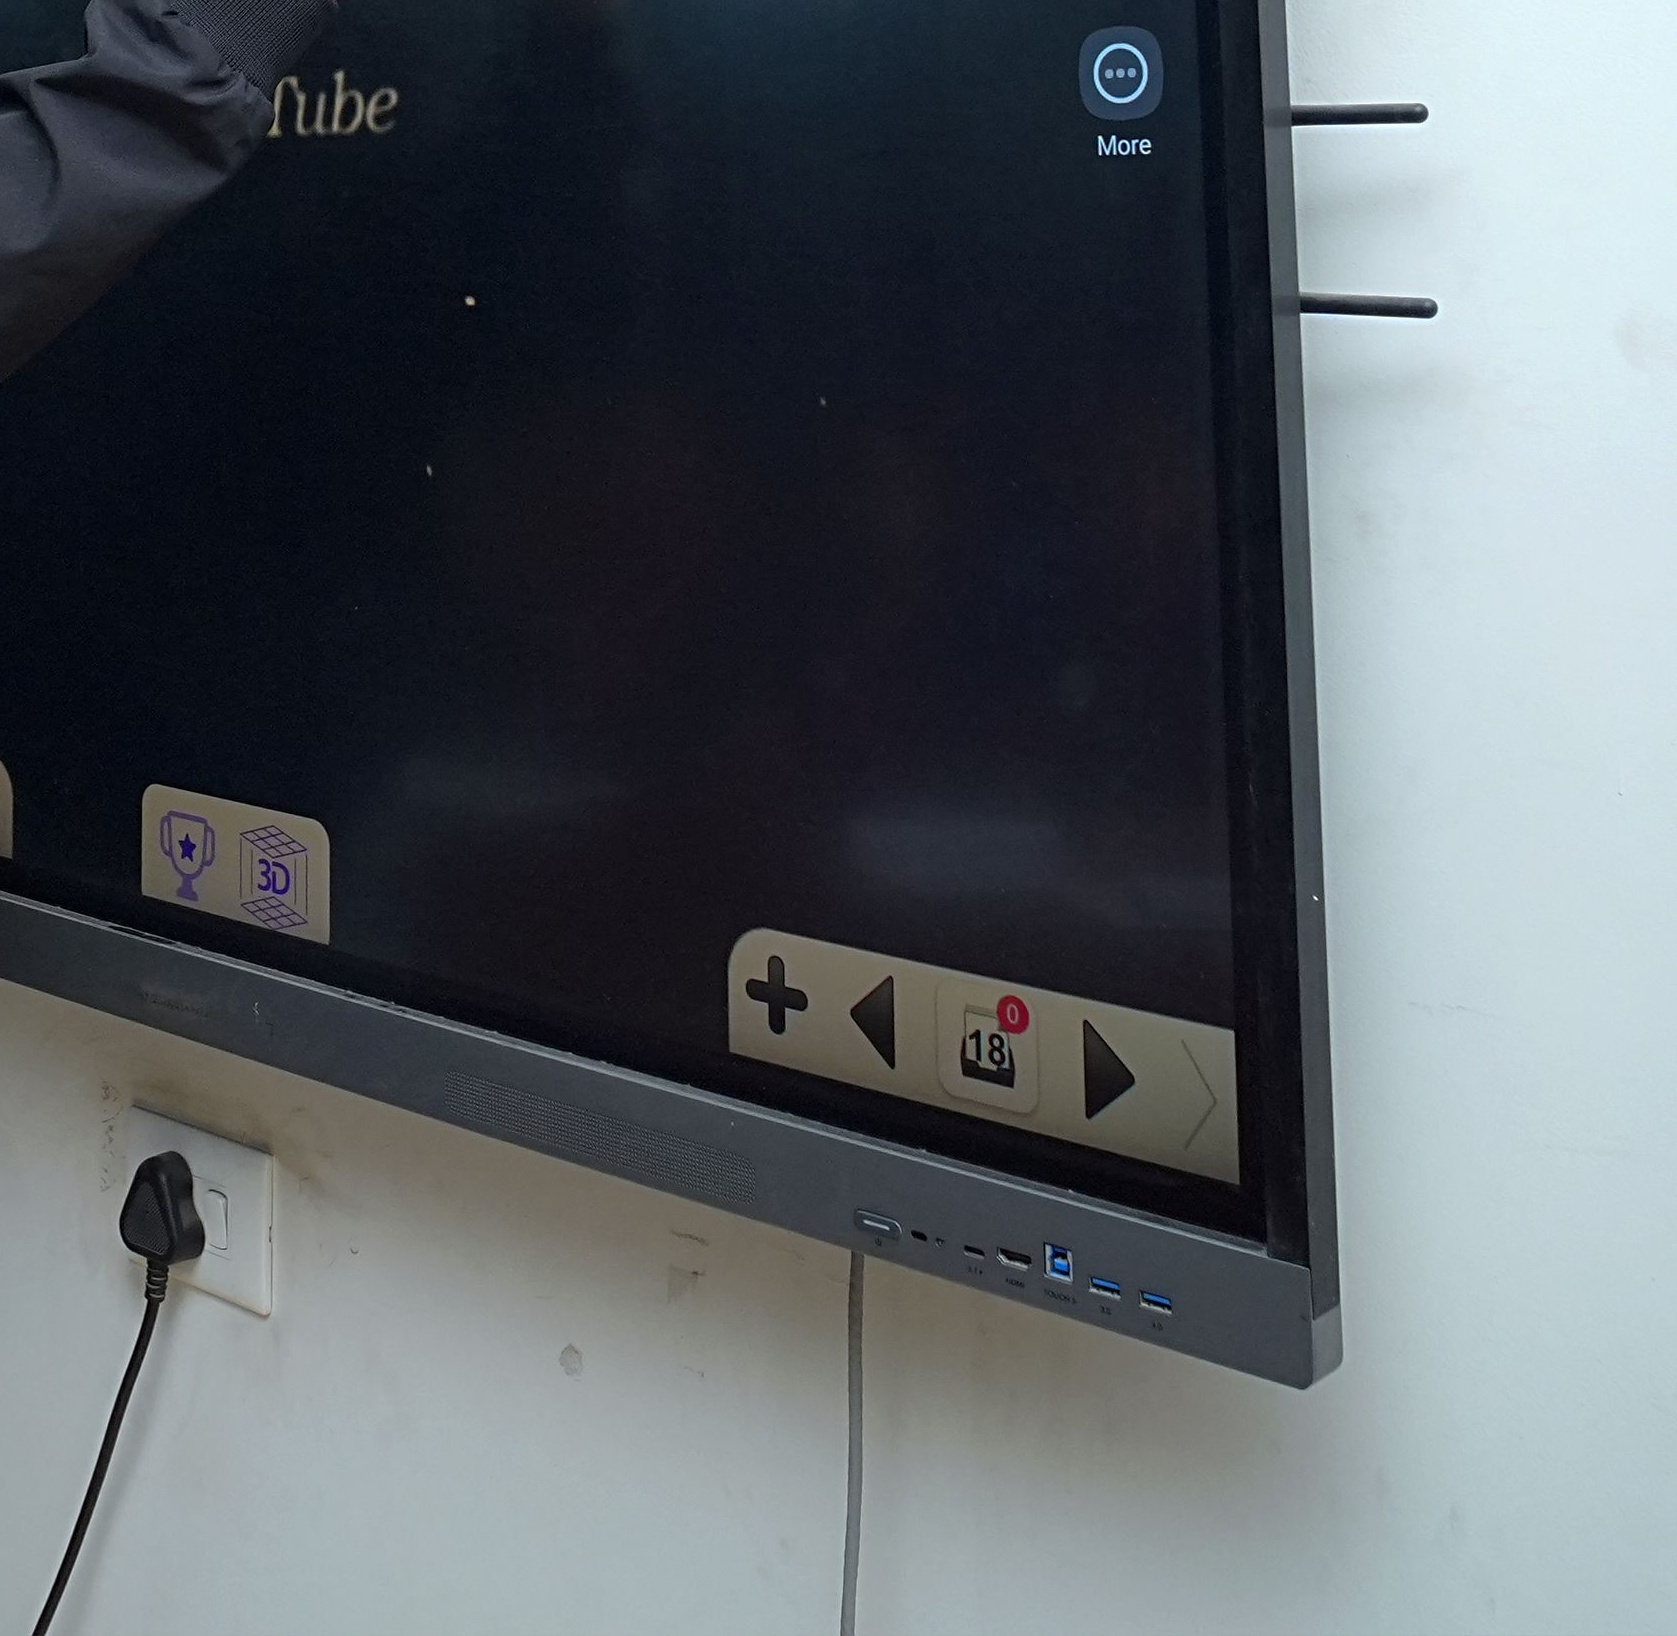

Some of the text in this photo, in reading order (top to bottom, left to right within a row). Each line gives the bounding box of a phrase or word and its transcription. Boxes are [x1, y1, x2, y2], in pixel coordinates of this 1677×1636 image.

[1097, 135, 1152, 157] More
[257, 858, 290, 895] 3D
[1006, 1003, 1019, 1024] 0
[968, 1029, 1006, 1066] 18
